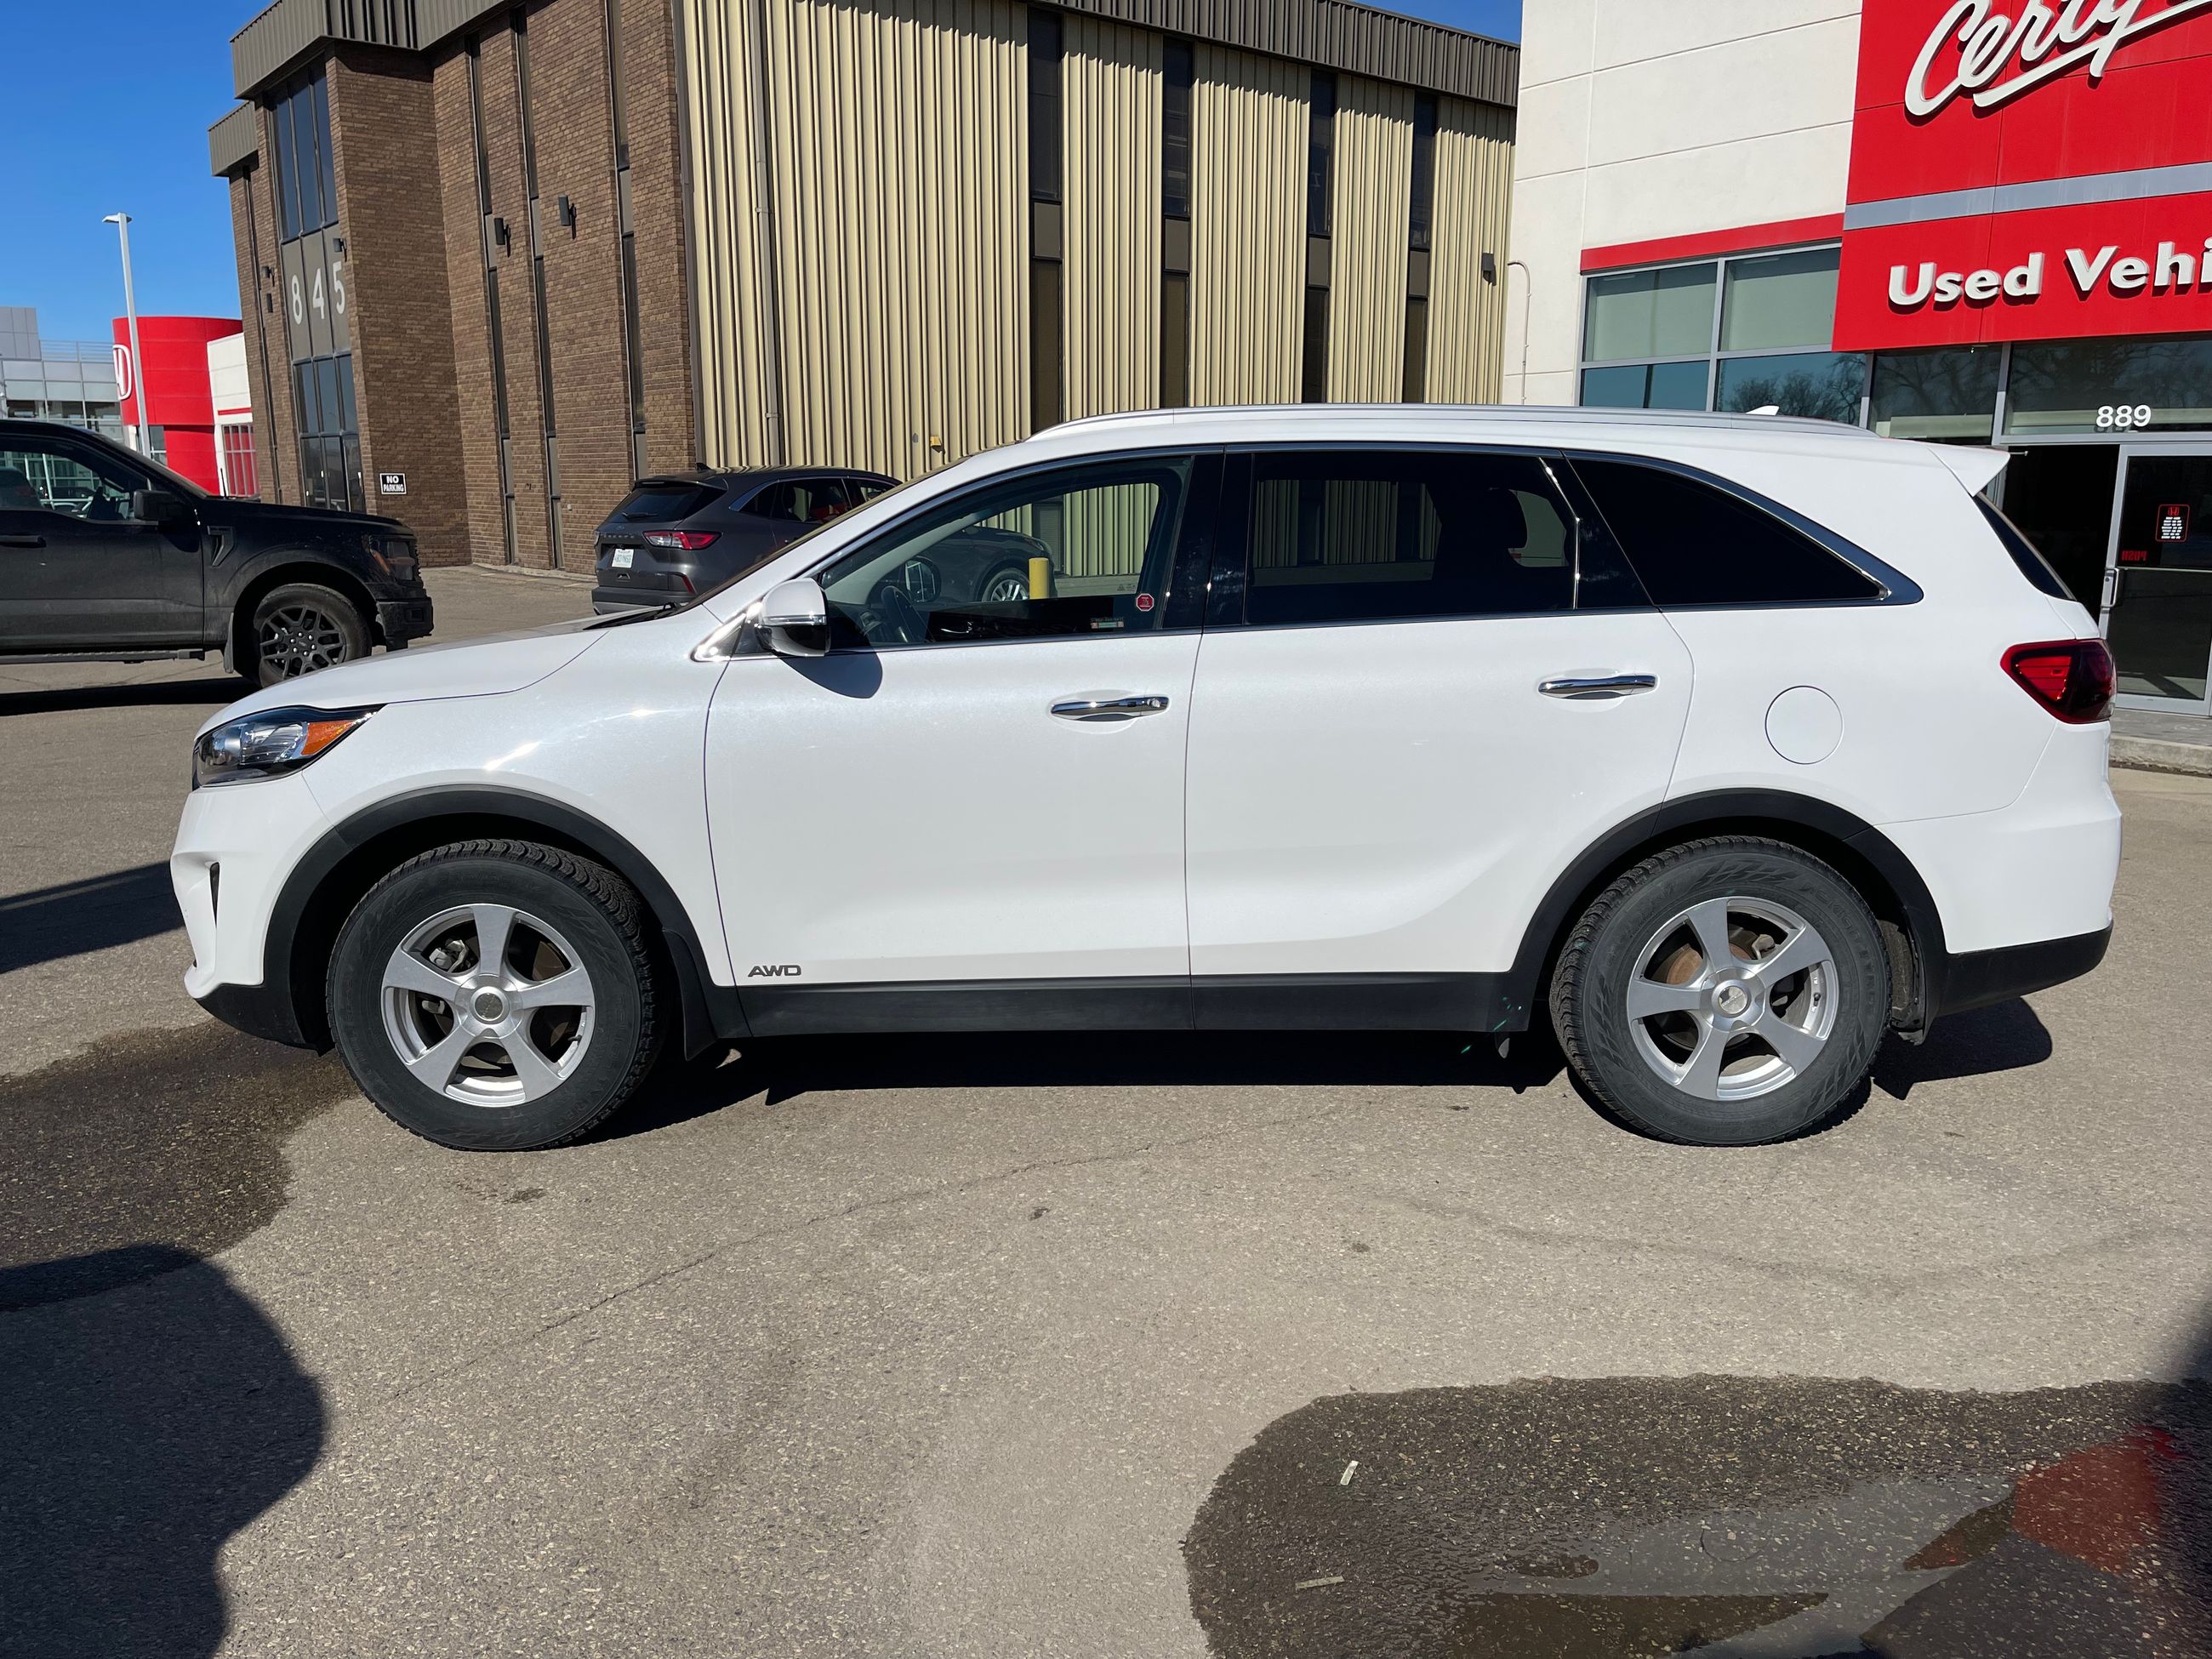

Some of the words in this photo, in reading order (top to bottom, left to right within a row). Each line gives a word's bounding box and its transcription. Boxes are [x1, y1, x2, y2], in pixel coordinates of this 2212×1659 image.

[1889, 253, 2044, 305] Used
[292, 260, 345, 325] 845
[2095, 404, 2152, 427] 889
[386, 476, 399, 484] NO
[748, 965, 801, 977] AWD
